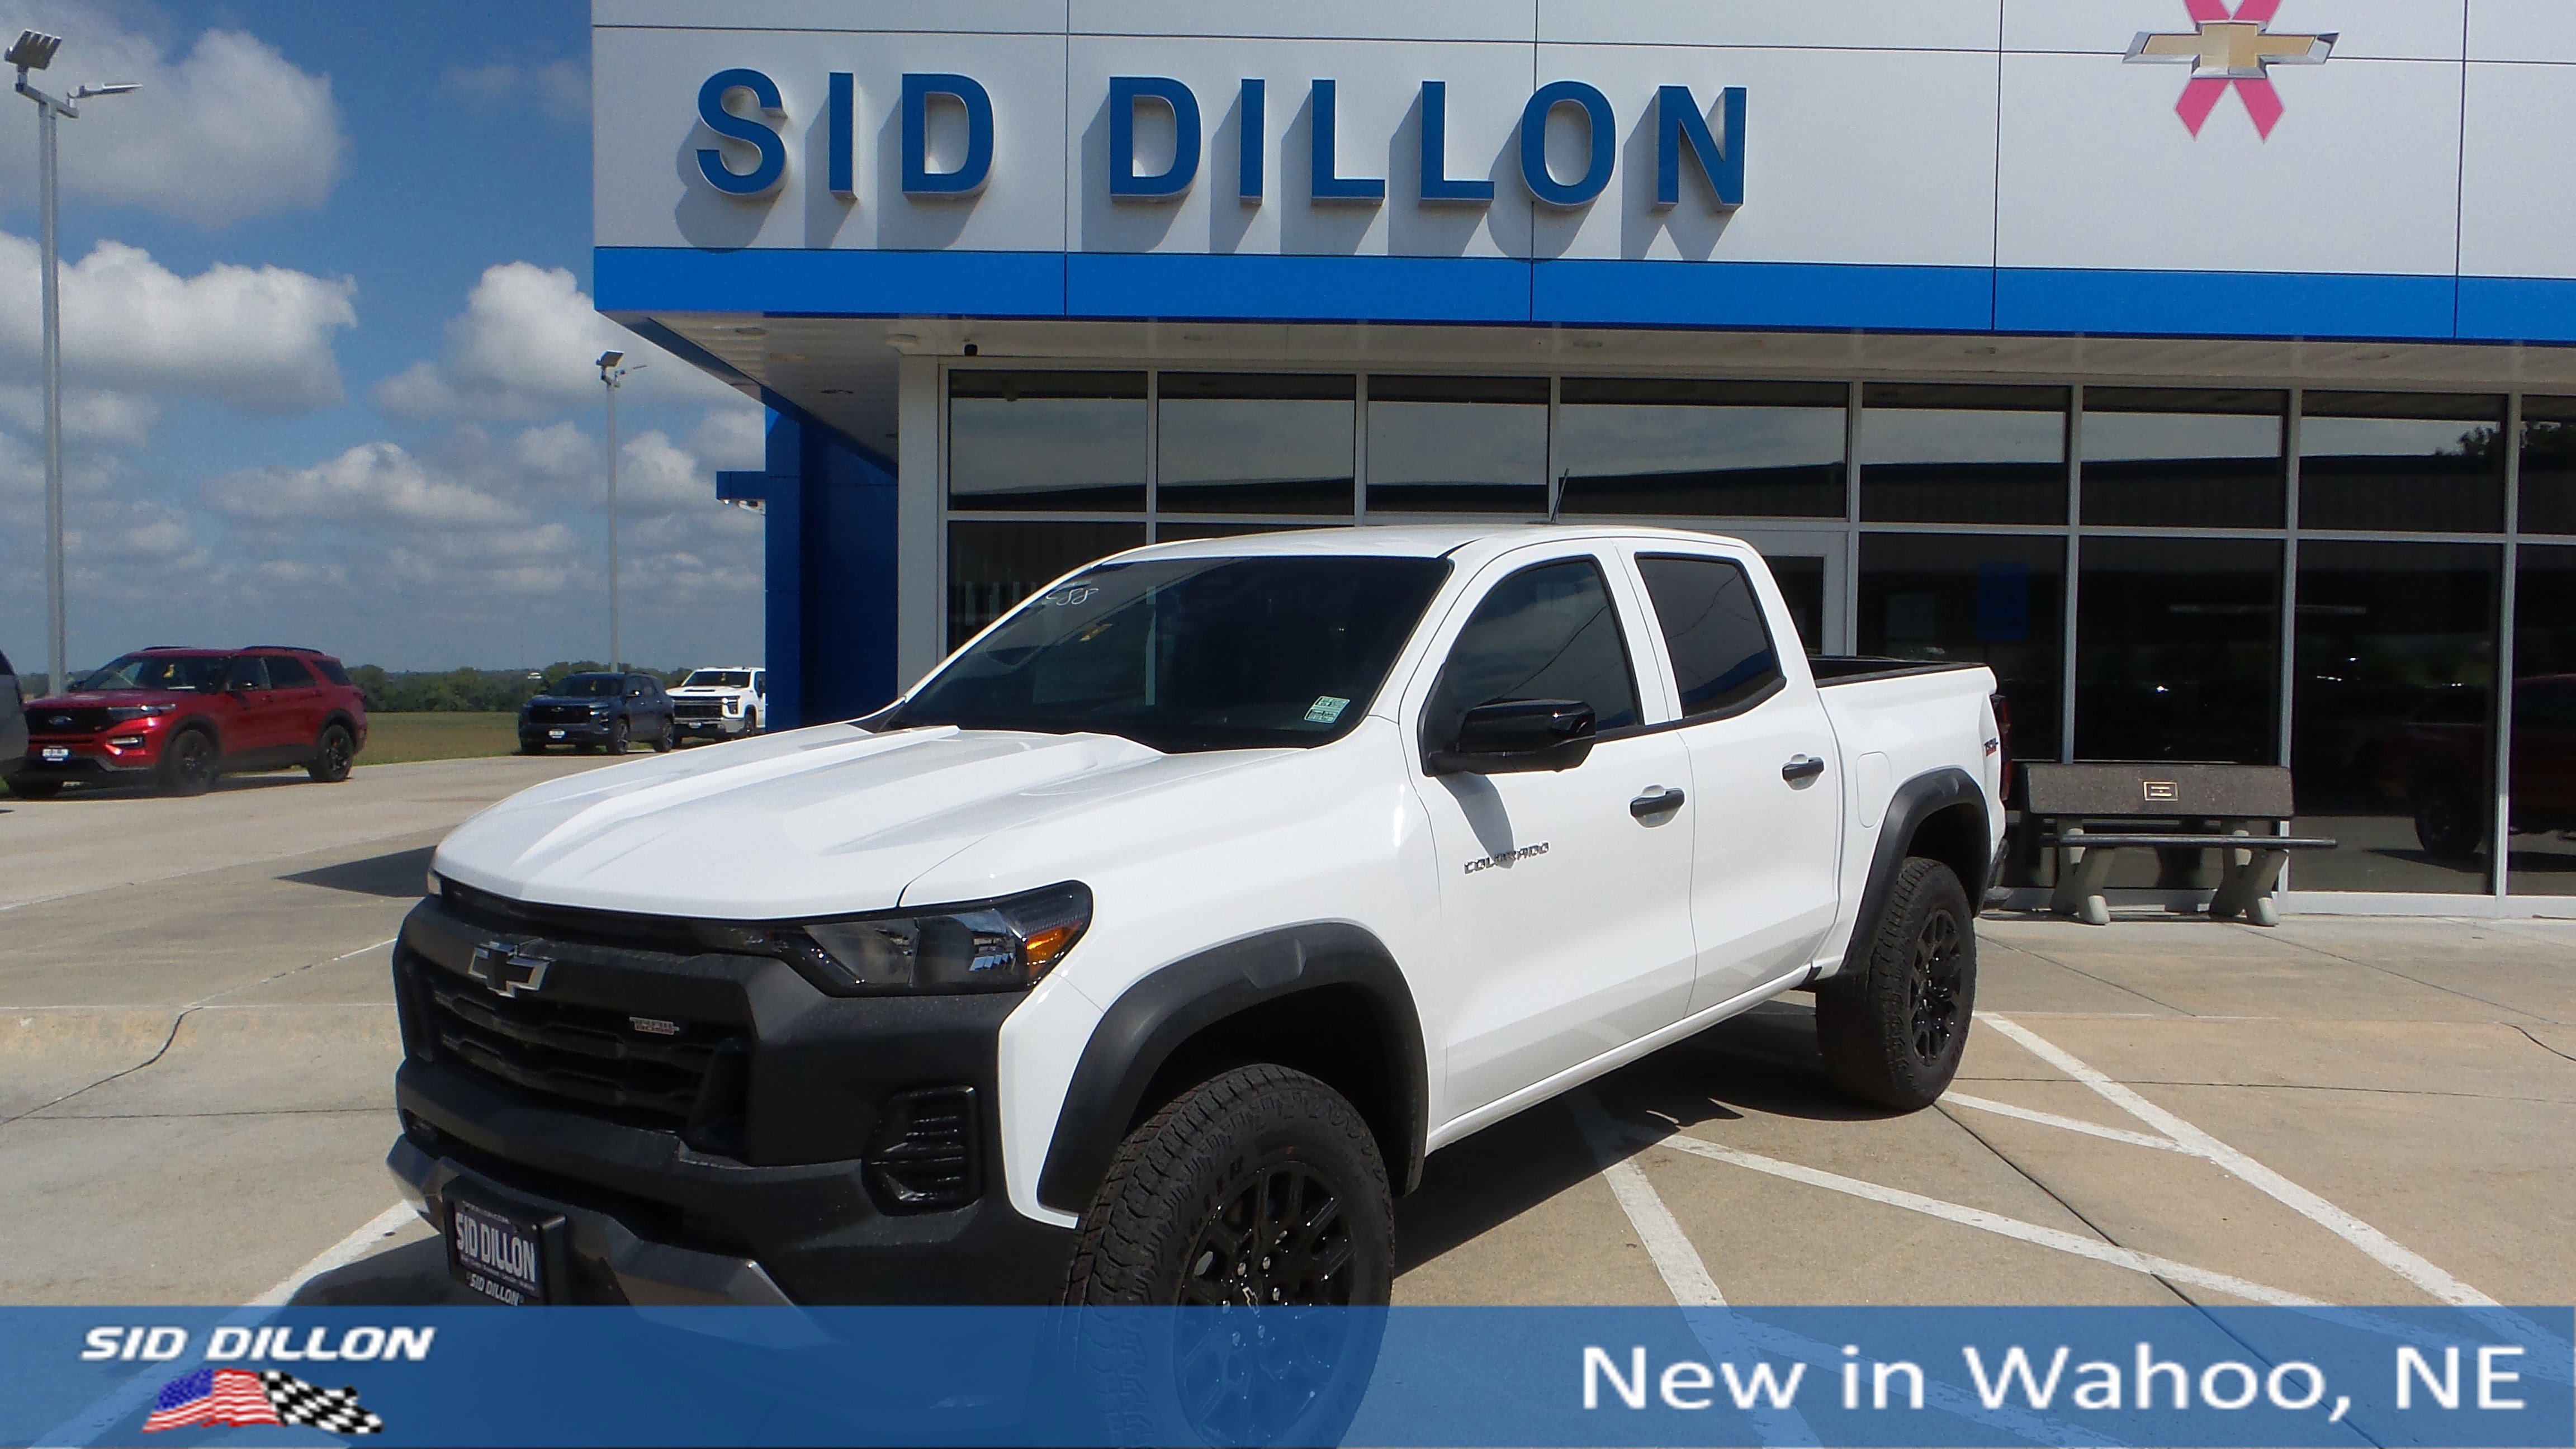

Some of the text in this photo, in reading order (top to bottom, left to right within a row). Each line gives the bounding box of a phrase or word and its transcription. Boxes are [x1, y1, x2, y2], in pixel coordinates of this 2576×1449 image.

[696, 67, 1747, 208] SID DILLON
[1464, 841, 1550, 874] COLORADO
[455, 1211, 479, 1258] SID
[480, 1222, 536, 1283] DILLON
[469, 1273, 520, 1306] SID DILLON
